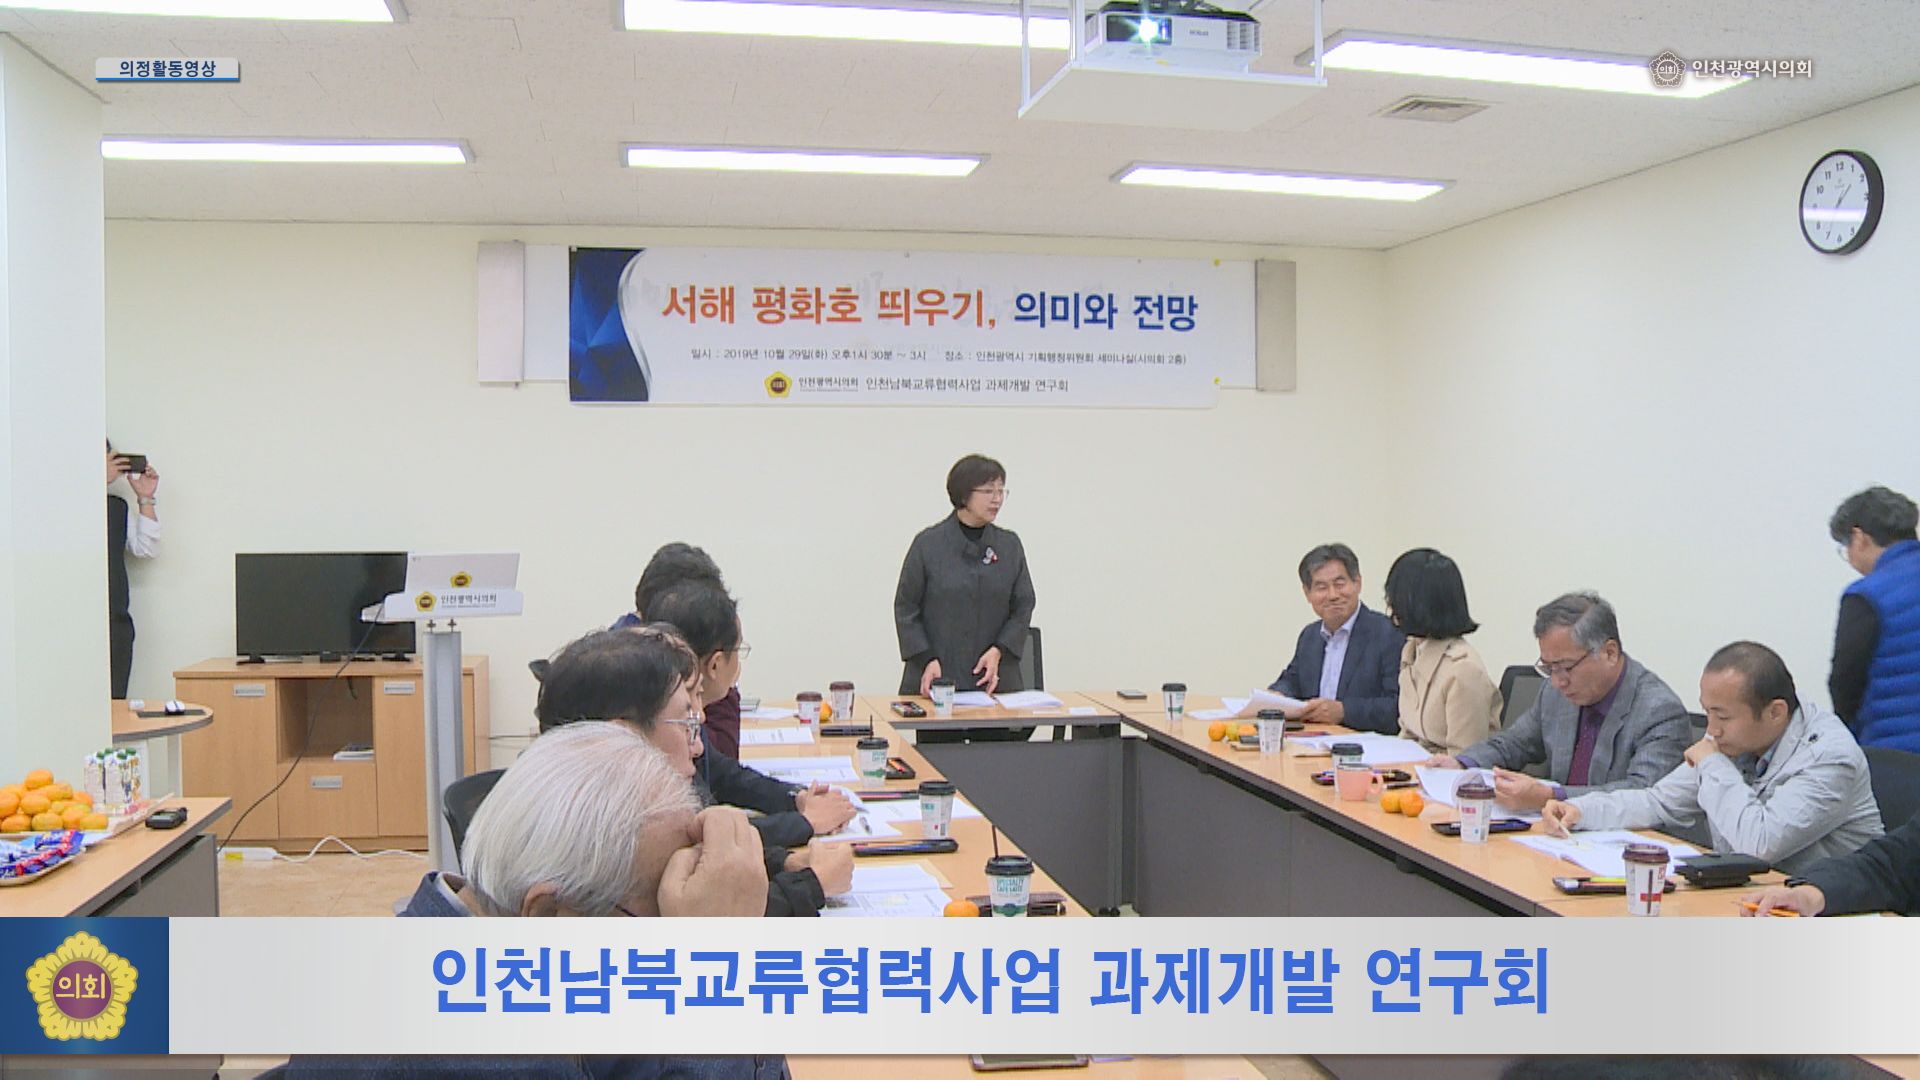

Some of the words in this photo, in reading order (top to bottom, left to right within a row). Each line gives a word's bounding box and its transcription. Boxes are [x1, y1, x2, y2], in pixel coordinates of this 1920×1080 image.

[661, 285, 735, 325] 서해
[752, 286, 863, 325] 평화호
[877, 287, 997, 329] 띄우기,
[1013, 290, 1119, 330] 의미와
[1132, 294, 1199, 332] 전망
[691, 348, 711, 360] 일시
[724, 348, 758, 360] 2019년
[764, 348, 785, 360] 10월
[788, 348, 828, 361] 29일(화)
[832, 349, 868, 361] 오후1시
[871, 350, 893, 361] 30분
[910, 350, 926, 361] 3시
[945, 351, 964, 362] 장소
[976, 351, 1024, 363] 인천광역시
[1028, 351, 1094, 364] 기획행정위원회
[798, 376, 859, 387] 인천광역시의회
[866, 377, 981, 392] 인천남북교류협력사업
[985, 378, 1030, 393] 과제개발
[1035, 380, 1069, 393] 연구회
[441, 593, 497, 604] 인천광역시의회
